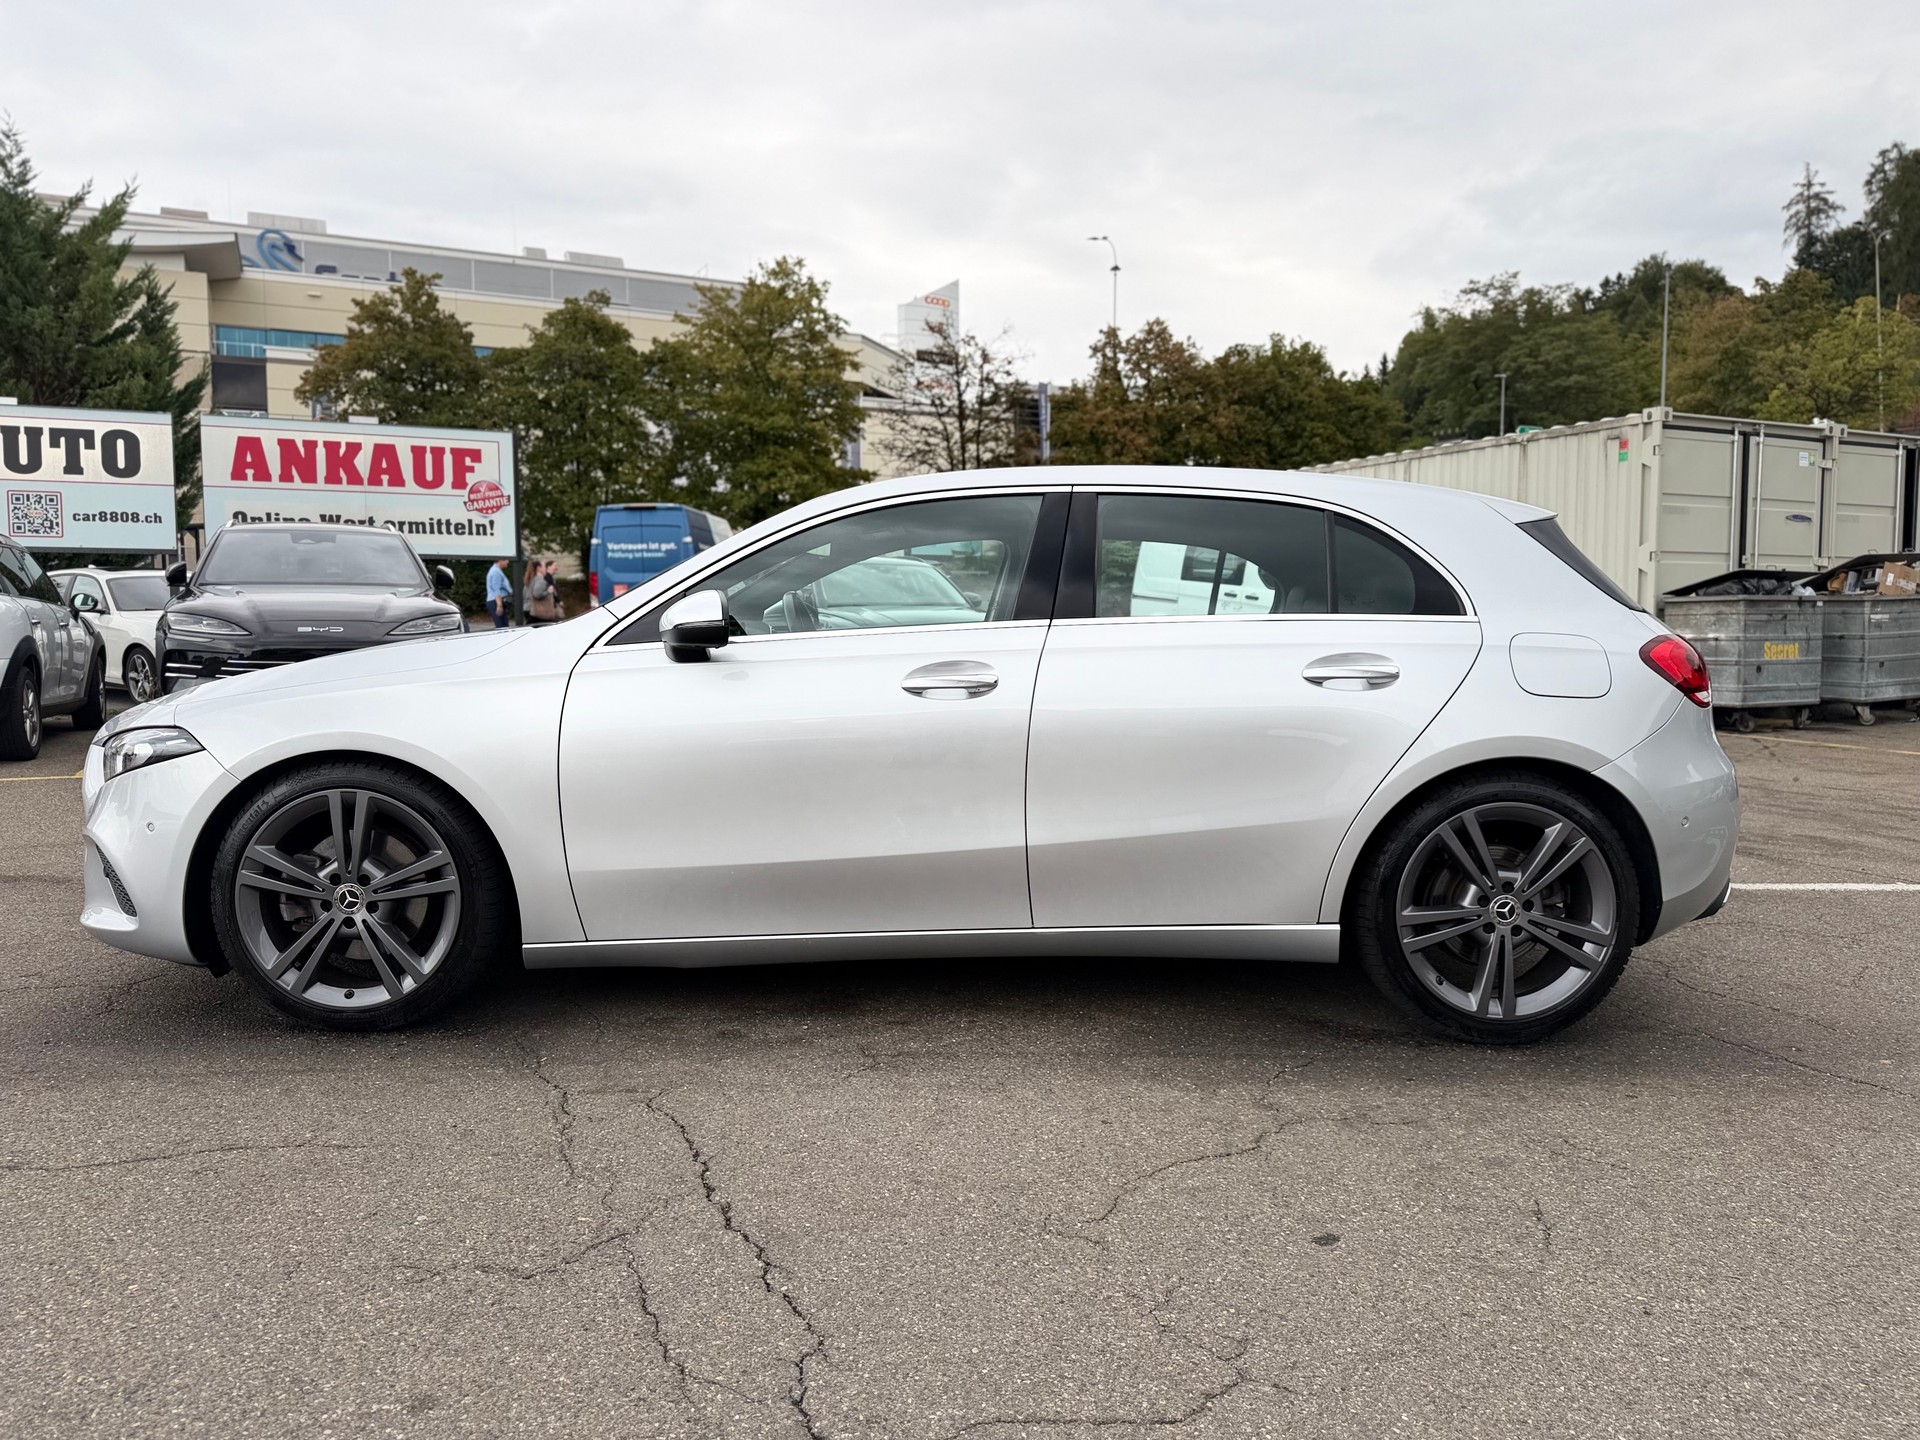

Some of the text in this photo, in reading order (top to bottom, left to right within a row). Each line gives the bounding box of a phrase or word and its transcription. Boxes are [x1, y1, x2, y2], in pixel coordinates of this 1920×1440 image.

[0, 425, 142, 479] UTO
[230, 436, 482, 491] ANKAUF
[466, 497, 509, 510] GARANTIE
[72, 511, 163, 524] car8808.ch
[607, 541, 677, 551] Vertrauen ist gut.
[1763, 641, 1799, 659] Secret
